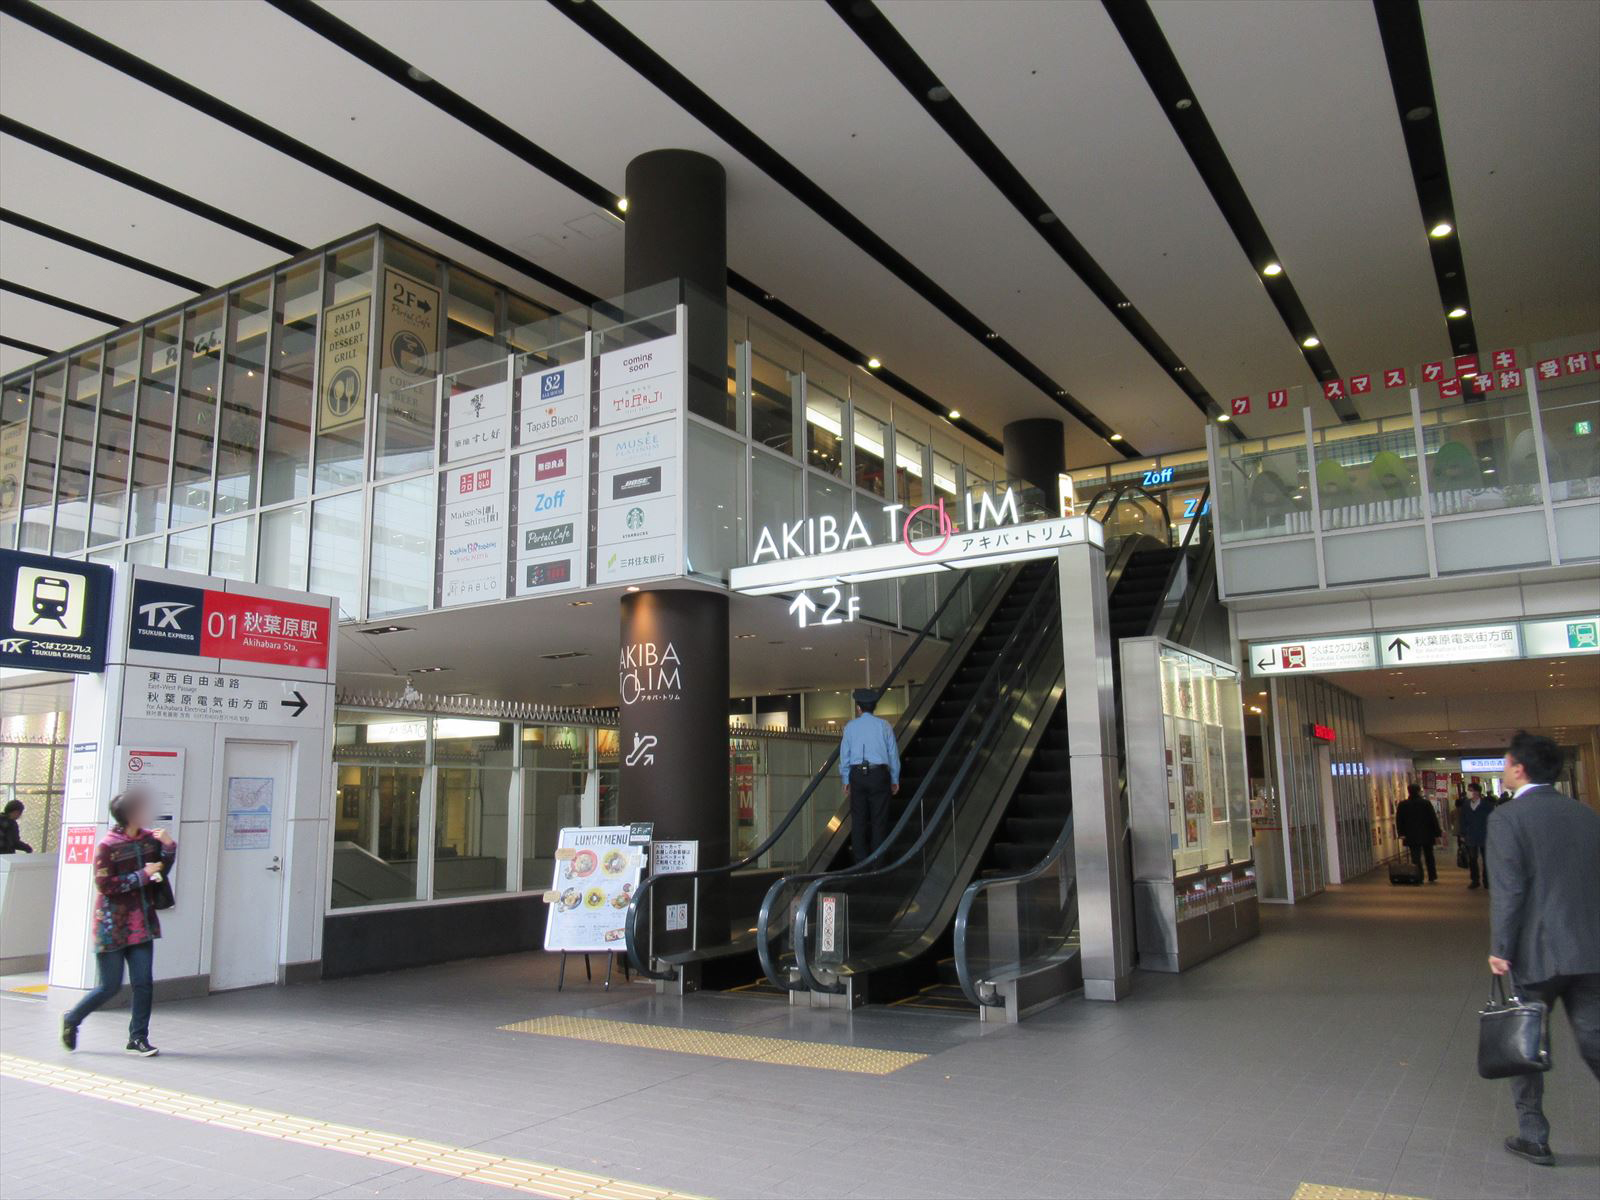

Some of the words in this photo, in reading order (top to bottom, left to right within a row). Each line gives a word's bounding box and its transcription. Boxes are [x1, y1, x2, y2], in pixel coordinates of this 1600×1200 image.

[393, 284, 416, 307] 2F
[335, 308, 361, 324] PASTA
[334, 321, 361, 337] SALAD
[329, 333, 364, 352] DESSERT
[334, 349, 358, 364] GRILL
[623, 352, 653, 367] coming
[629, 362, 649, 373] soon
[1442, 371, 1520, 395] ご予約
[1540, 354, 1600, 378] 受付
[544, 374, 561, 392] 82
[613, 390, 663, 411] TORAJI
[526, 420, 550, 433] Tapas
[551, 414, 578, 428] Blanco
[1143, 468, 1173, 486] Zoff
[535, 490, 565, 512] Zoff
[528, 531, 553, 544] Portal
[553, 525, 570, 543] Cafe
[753, 511, 872, 563] AKIBA
[962, 525, 1072, 552] アキバ・トリム
[620, 553, 664, 568] 三井住友銀行
[822, 587, 860, 625] 2F
[139, 601, 196, 630] TX
[137, 628, 166, 638] TSUKUBA
[167, 632, 195, 641] EXPRESS
[207, 611, 238, 640] 01
[243, 611, 318, 640] 秋葉原駅
[243, 637, 281, 650] Akihabara
[283, 642, 298, 652] Sta.
[1415, 629, 1513, 647] 秋葉原電気街方面
[31, 649, 61, 657] TSUKUBA
[62, 652, 91, 660] EXPRESS
[620, 642, 681, 669] AKIBA
[149, 671, 240, 689] 東西自由通路
[147, 691, 268, 710] 秋葉原電気街方面
[575, 834, 603, 846] LUNCH
[604, 833, 628, 845] MENU
[67, 847, 89, 862] A-1
